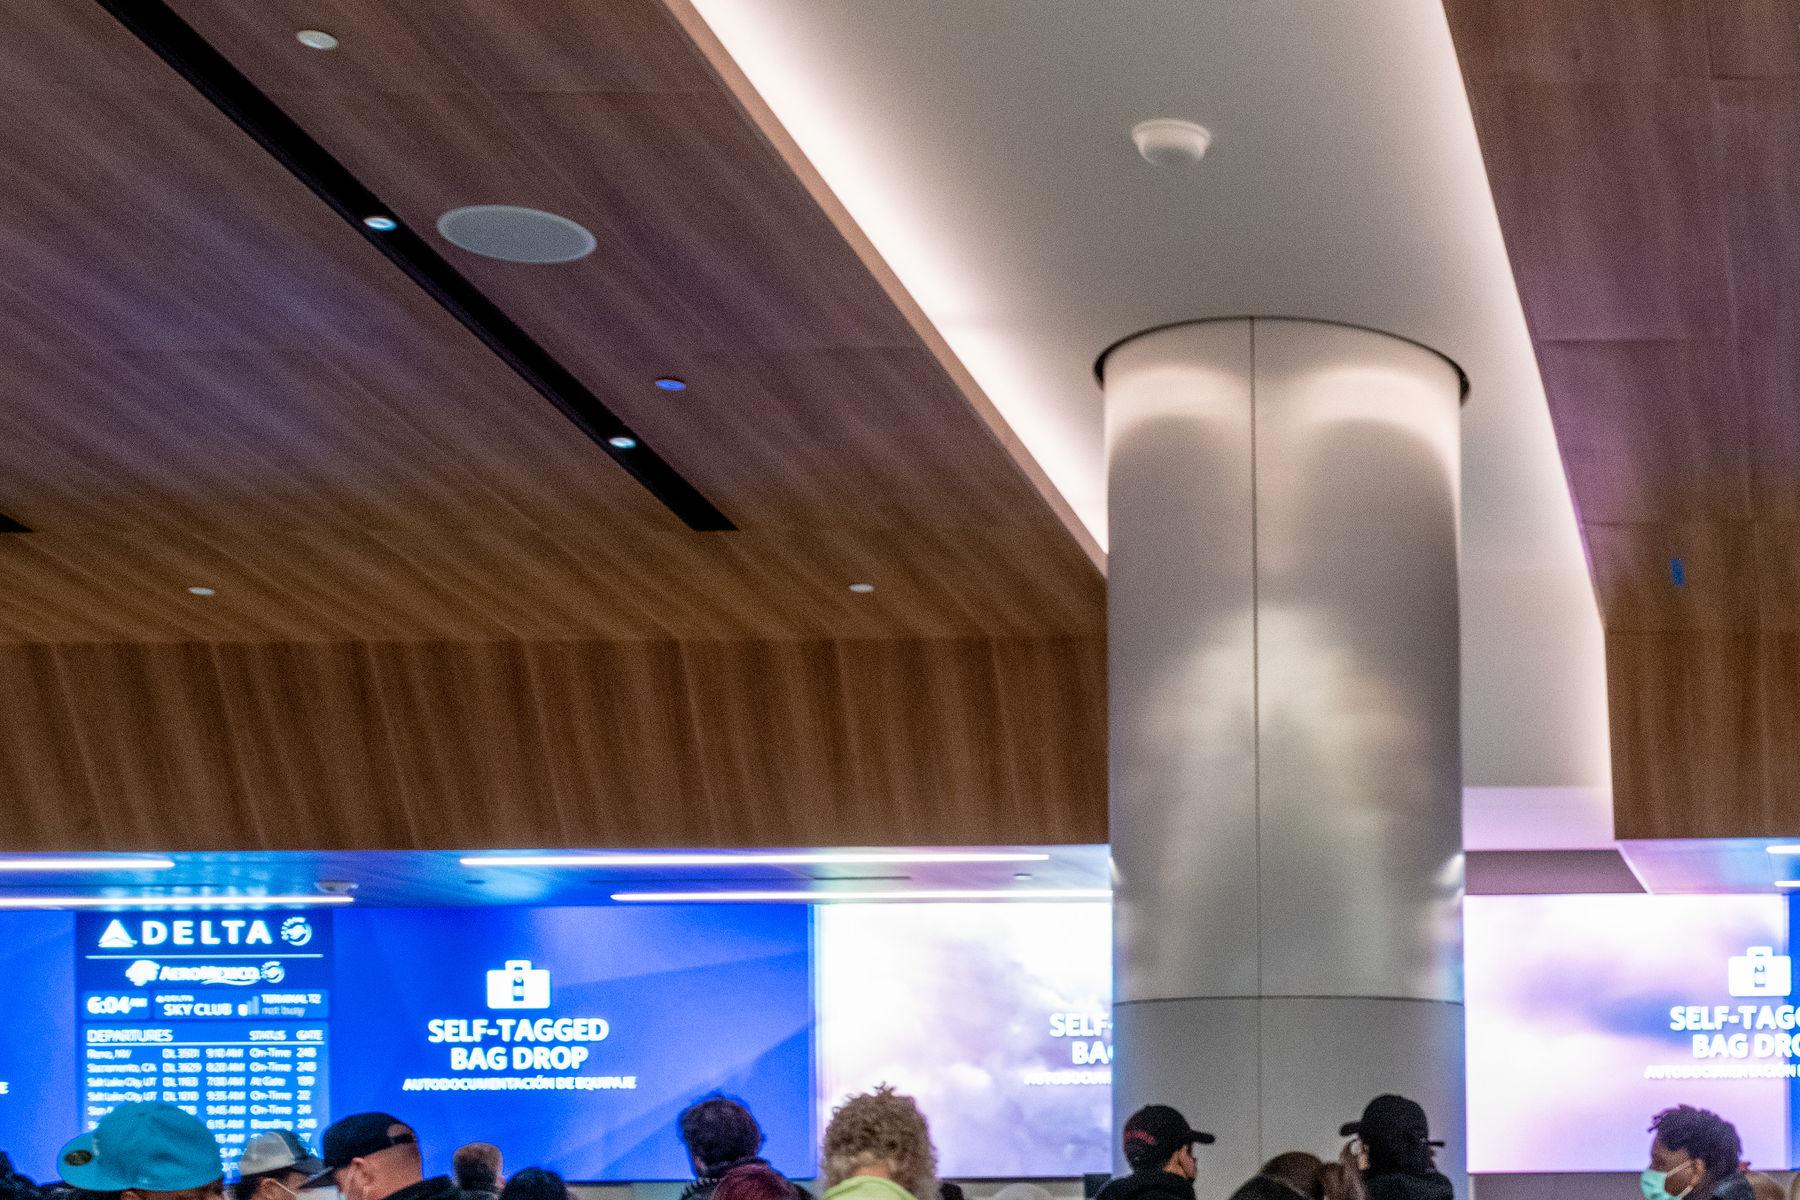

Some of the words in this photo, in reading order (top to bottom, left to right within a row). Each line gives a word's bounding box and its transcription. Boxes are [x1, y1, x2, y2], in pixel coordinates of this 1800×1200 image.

[142, 920, 272, 944] DELTA
[262, 995, 308, 1004] TERMINAL
[164, 1004, 193, 1015] SKY
[194, 1004, 232, 1015] CLUB
[281, 1007, 305, 1016] busy
[249, 1031, 286, 1040] STATUS
[296, 1030, 323, 1040] GATE
[428, 1018, 609, 1042] SELF-TAGGED
[87, 1030, 173, 1042] DEPARTURES
[1692, 1033, 1748, 1058] BAG
[250, 1048, 291, 1058] On-Time
[451, 1047, 507, 1070] BAG
[513, 1046, 588, 1070] DROP
[1072, 1042, 1112, 1064] BA
[250, 1062, 292, 1072] On-Time
[262, 1076, 286, 1086] Gate
[556, 1077, 574, 1089] DE
[250, 1090, 292, 1101] On-Time
[250, 1105, 292, 1115] On-Time
[250, 1119, 293, 1131] Boarding
